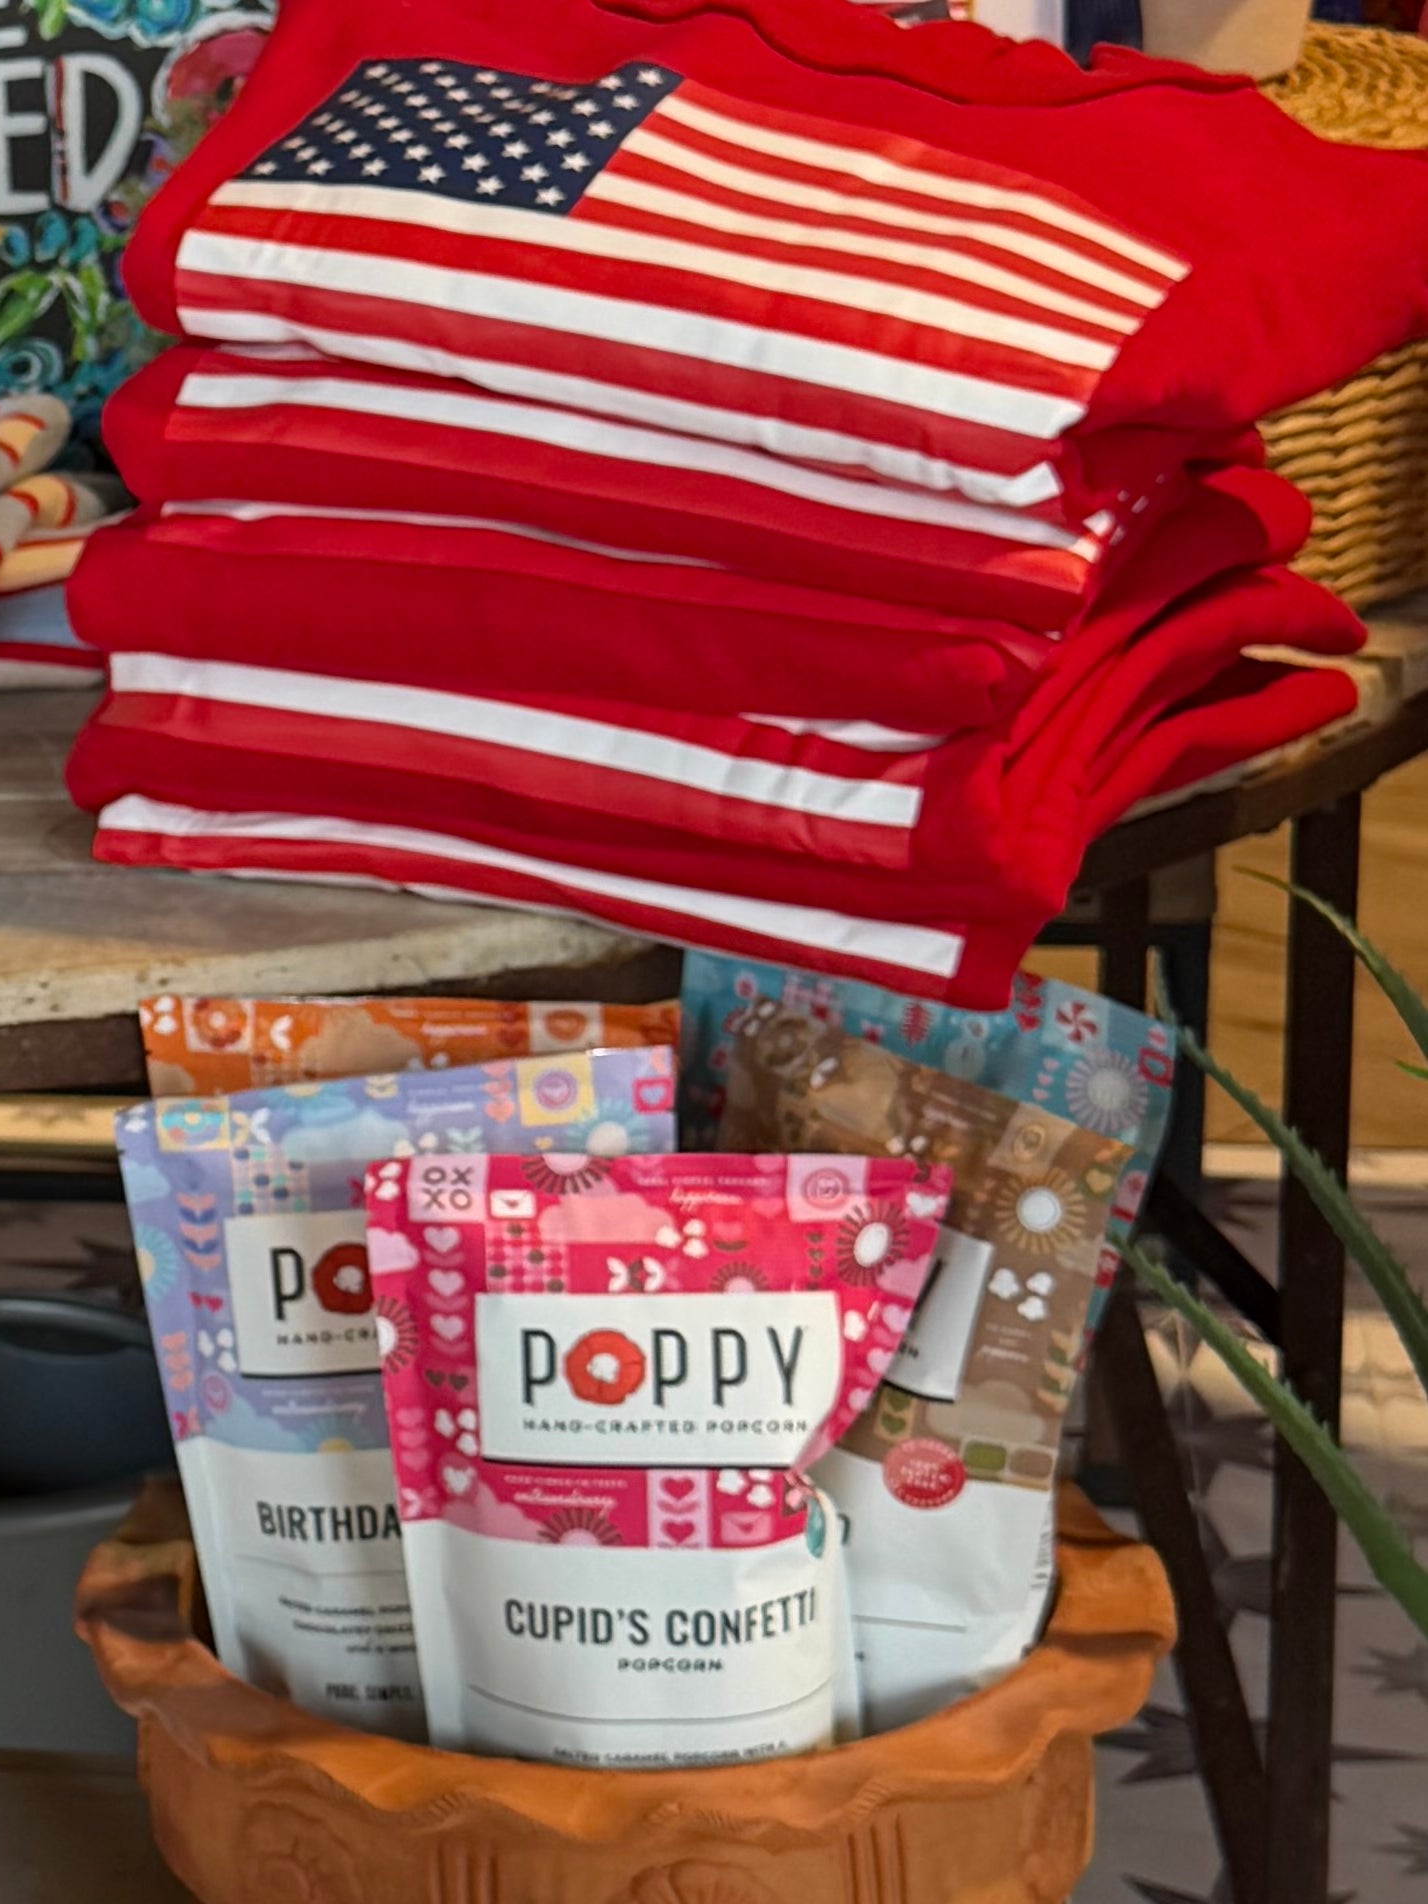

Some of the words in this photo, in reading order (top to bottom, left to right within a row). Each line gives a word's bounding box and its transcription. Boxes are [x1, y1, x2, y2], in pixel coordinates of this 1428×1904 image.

[522, 1418, 695, 1434] HAND-CRAFTED
[706, 1418, 808, 1434] POPCORN
[256, 1501, 403, 1542] BIRTHDA
[504, 1598, 650, 1647] CUPID'S
[665, 1586, 817, 1647] CONFETTI
[617, 1658, 724, 1672] POPCORN
